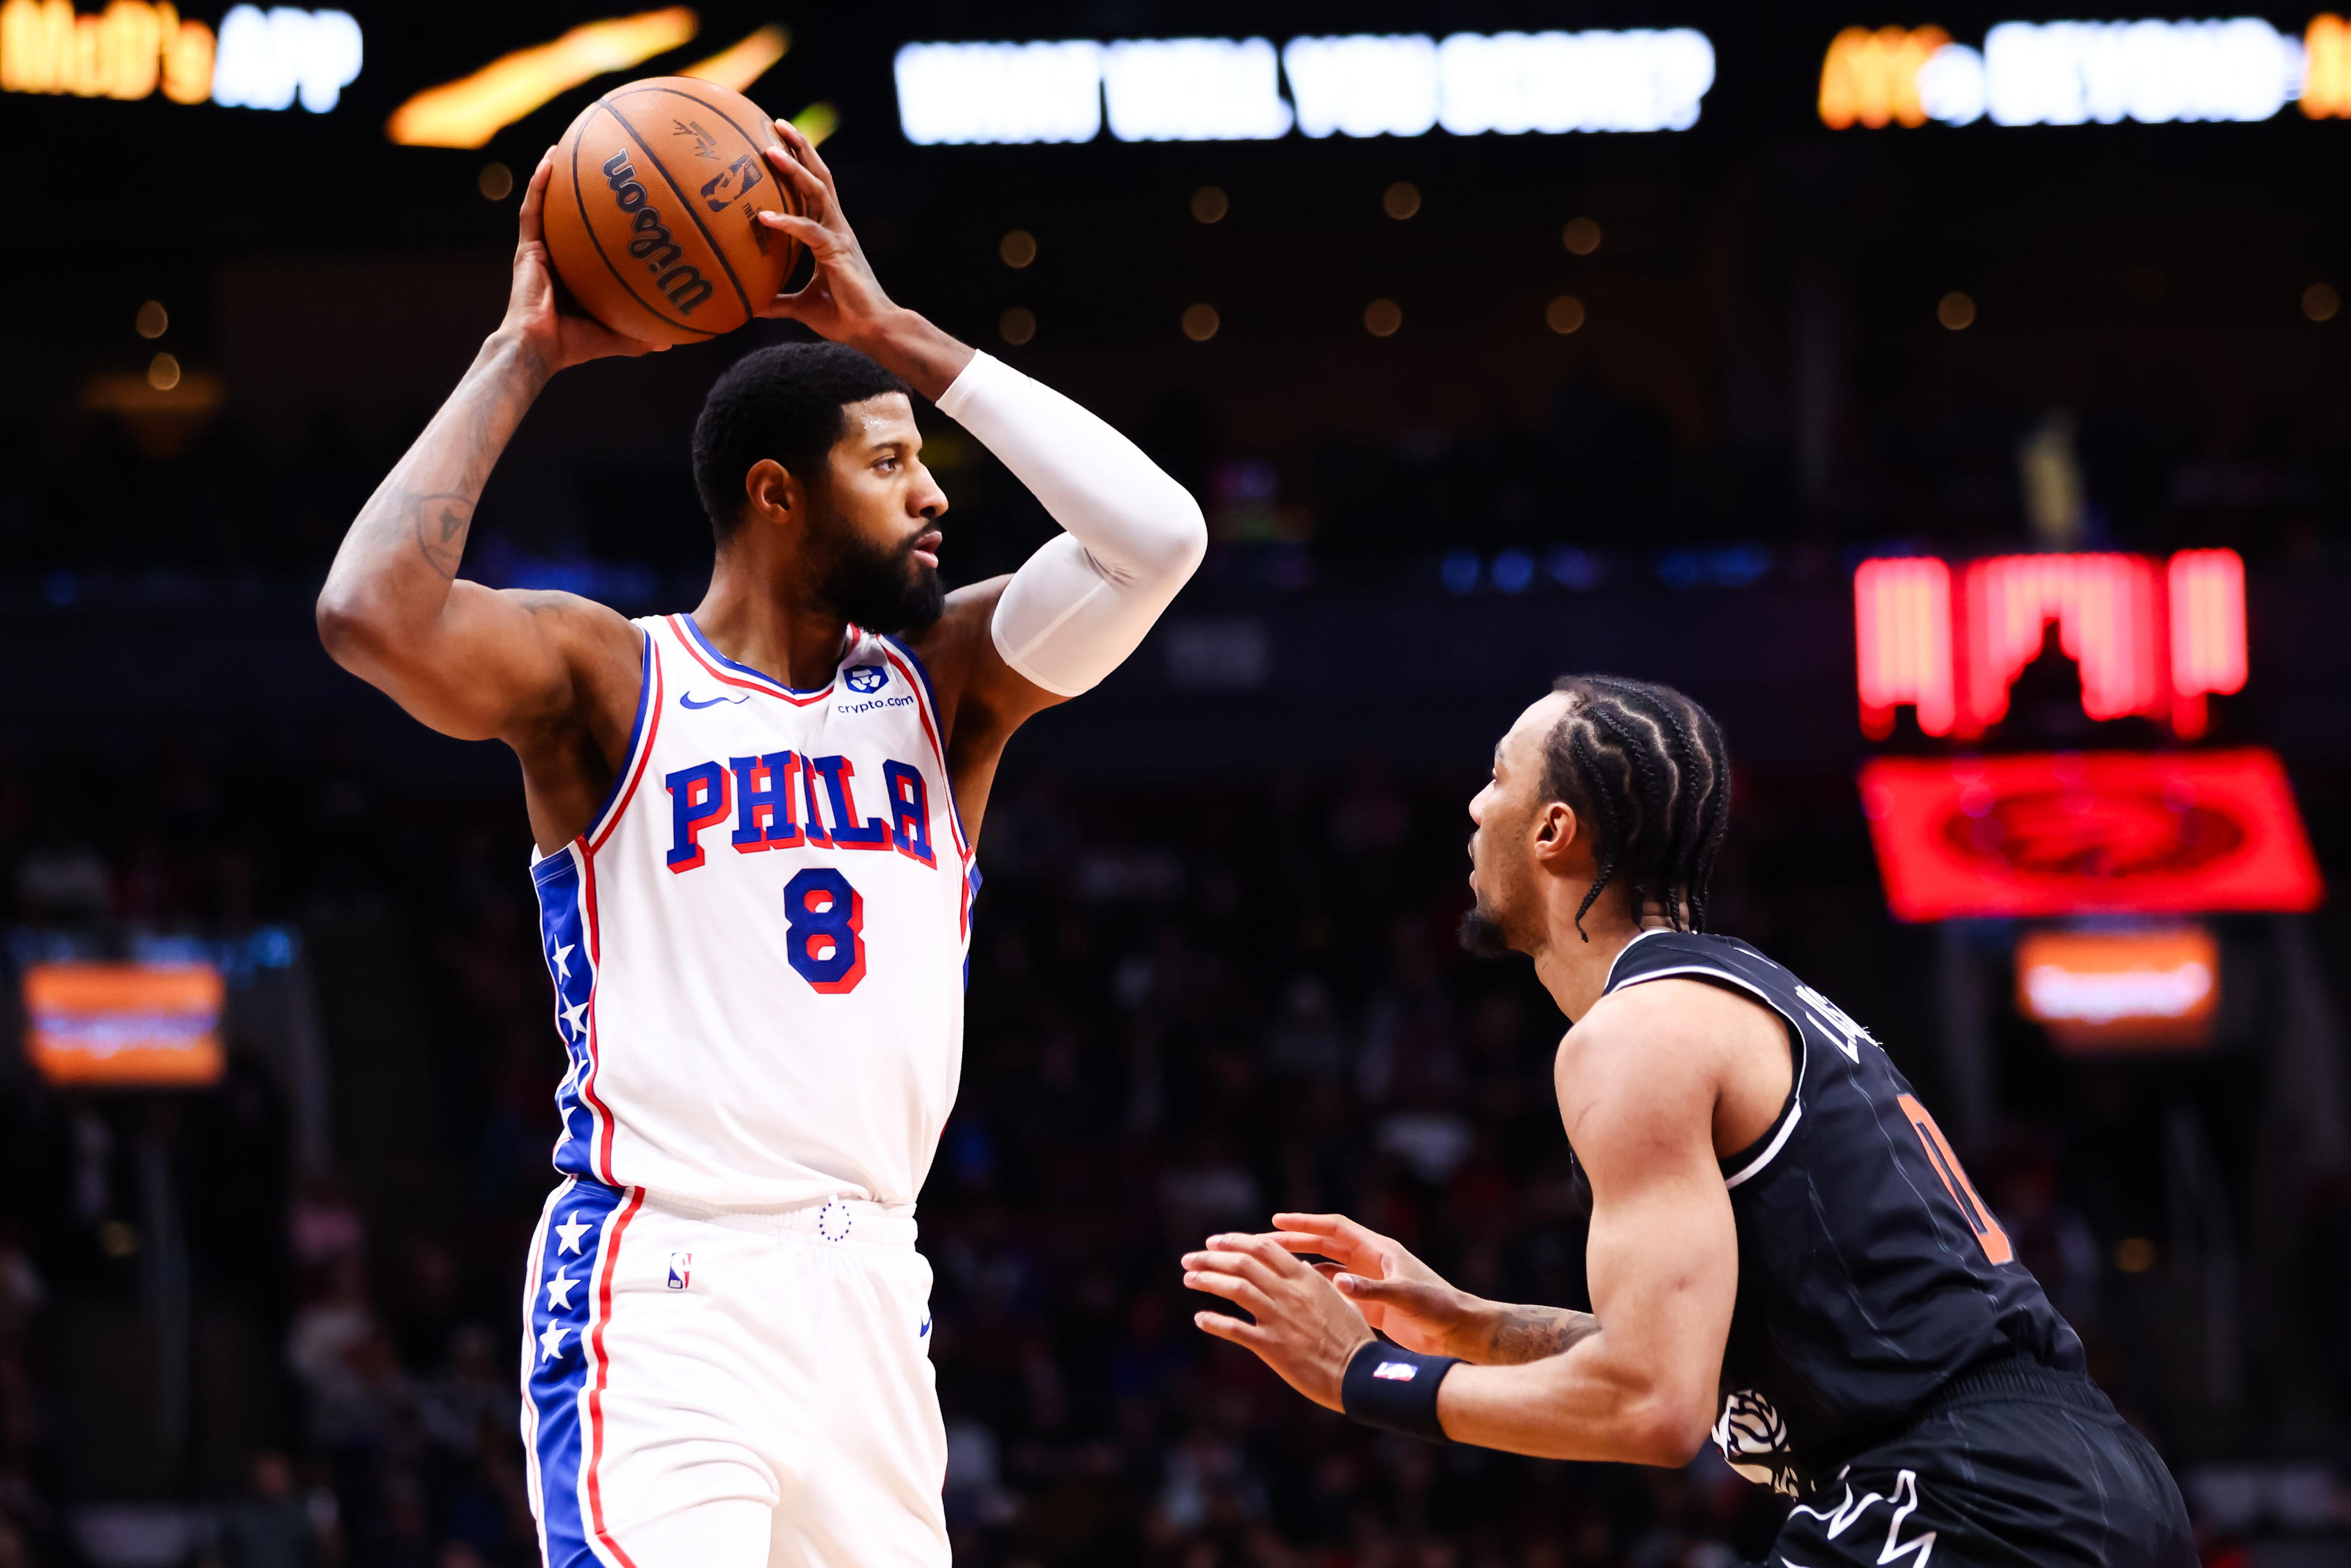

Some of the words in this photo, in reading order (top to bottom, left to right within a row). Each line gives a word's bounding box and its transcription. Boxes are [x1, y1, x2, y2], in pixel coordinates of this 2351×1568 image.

[601, 148, 714, 316] Wilson
[838, 695, 914, 713] crypto.com
[665, 750, 937, 874] PHILA
[783, 868, 866, 994] 8
[1897, 1093, 2014, 1266] 0
